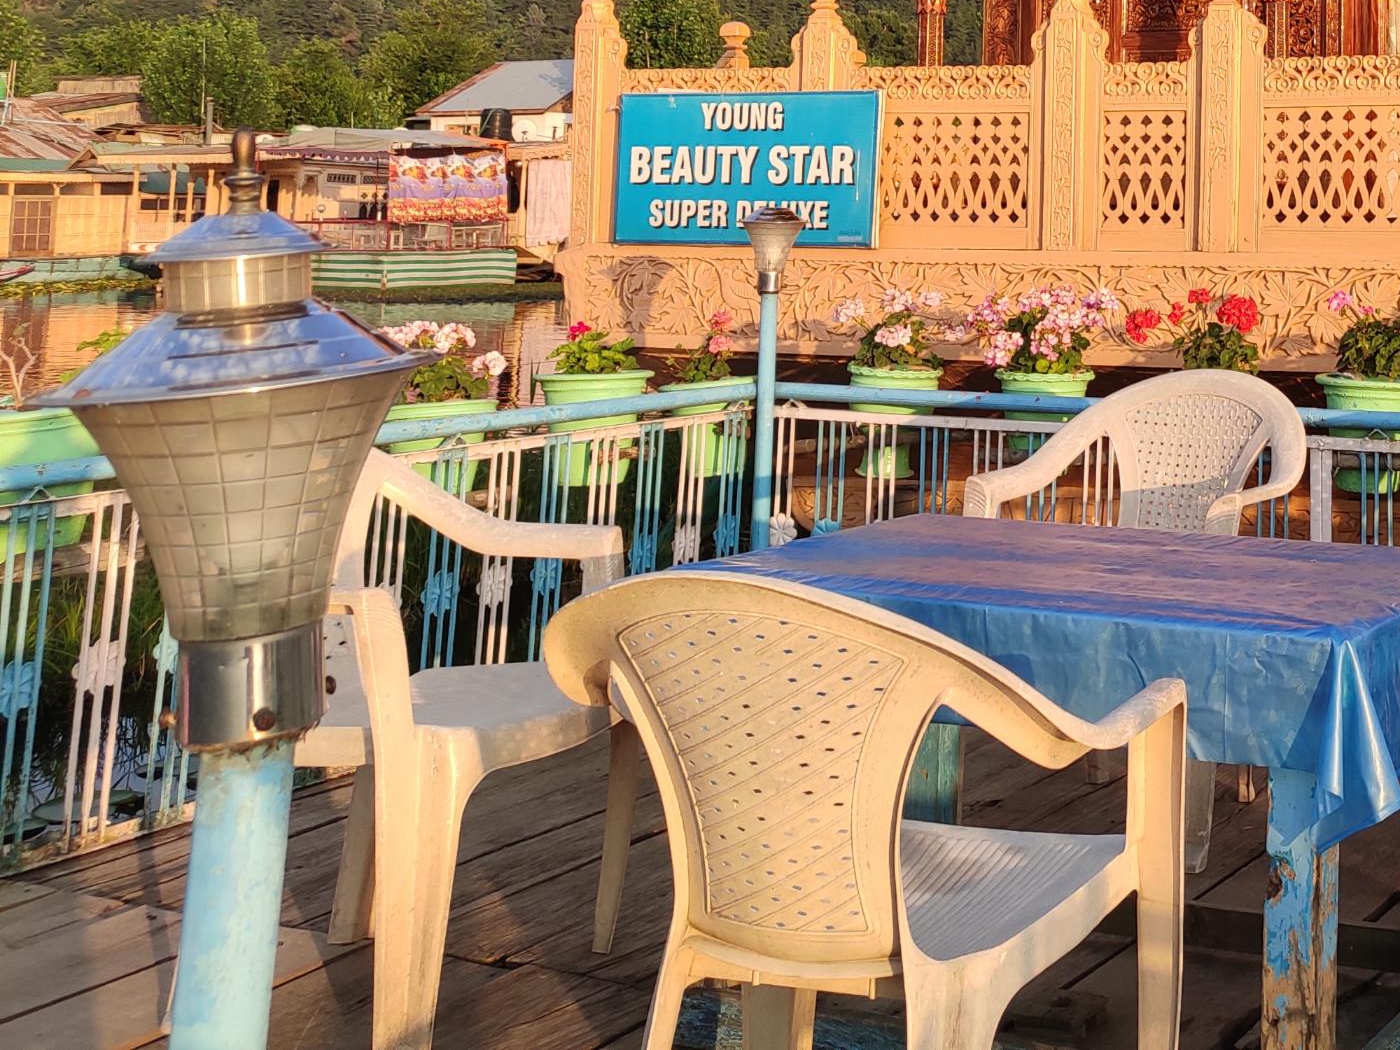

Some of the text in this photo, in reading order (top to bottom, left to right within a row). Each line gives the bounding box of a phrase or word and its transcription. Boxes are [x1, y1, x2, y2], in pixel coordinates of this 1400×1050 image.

[701, 101, 785, 131] YOUNG
[629, 145, 855, 185] BEAUTY STAR
[648, 199, 829, 230] SUPER DXE
